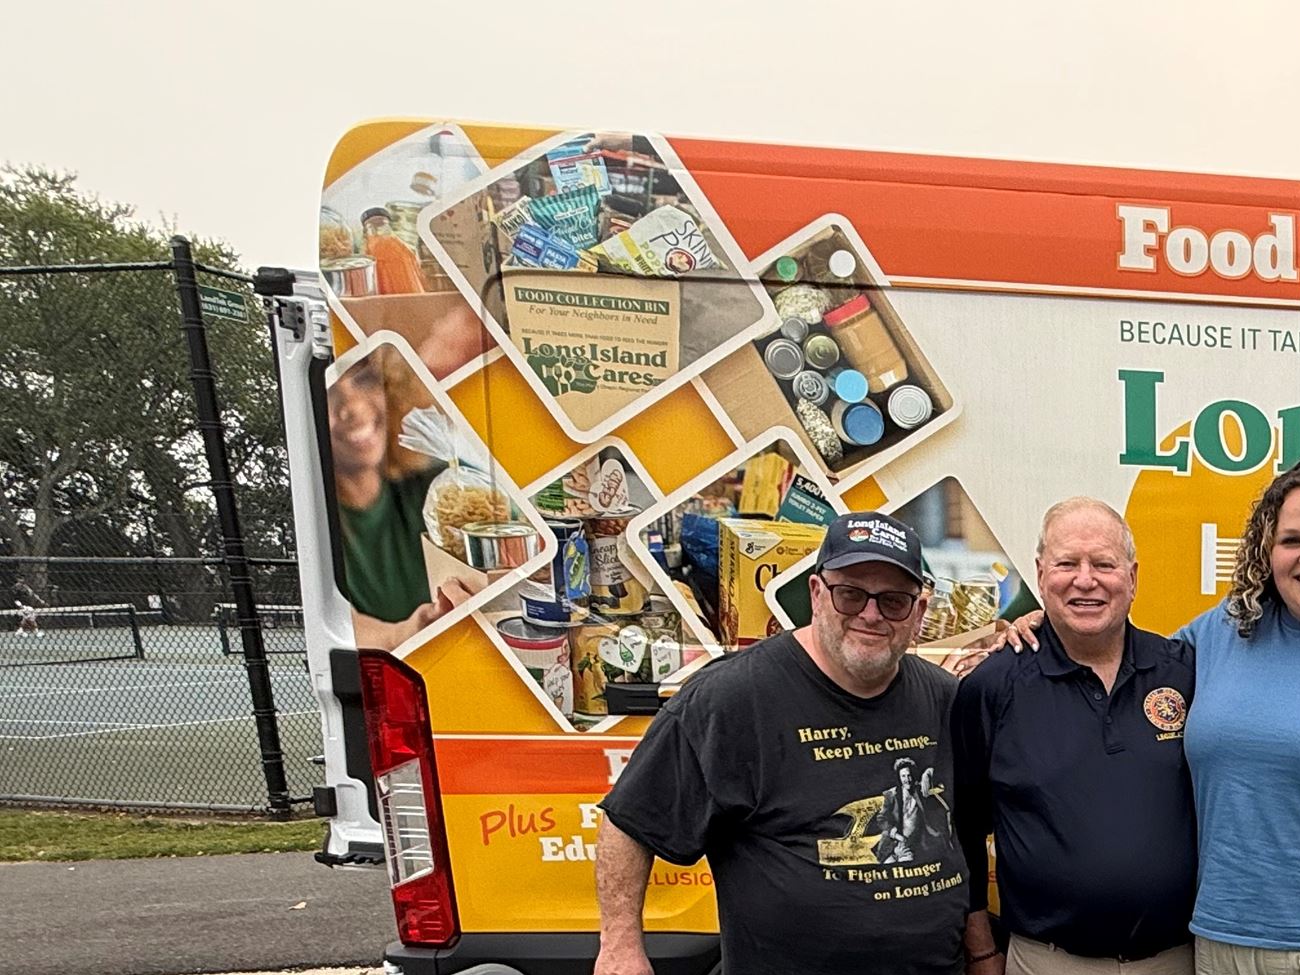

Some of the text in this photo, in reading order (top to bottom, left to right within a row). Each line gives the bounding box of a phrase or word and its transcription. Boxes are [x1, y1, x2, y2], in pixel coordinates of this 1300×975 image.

[1117, 204, 1299, 282] Food
[517, 289, 668, 313] FOOD COLLECTION BIN
[528, 305, 659, 325] For Your Neighbors in Need
[1120, 319, 1233, 349] BECAUSE
[1241, 328, 1262, 350] IT
[522, 337, 668, 369] Long Island
[583, 363, 655, 387] Cares
[847, 519, 874, 530] Long
[798, 726, 852, 743] Harry,
[813, 747, 853, 761] Keep
[855, 741, 883, 756] The
[479, 803, 556, 846] Plus
[648, 872, 713, 886] LUSIO
[847, 868, 888, 884] Fight
[892, 862, 941, 879] Hunger
[874, 872, 963, 901] on Long Island
